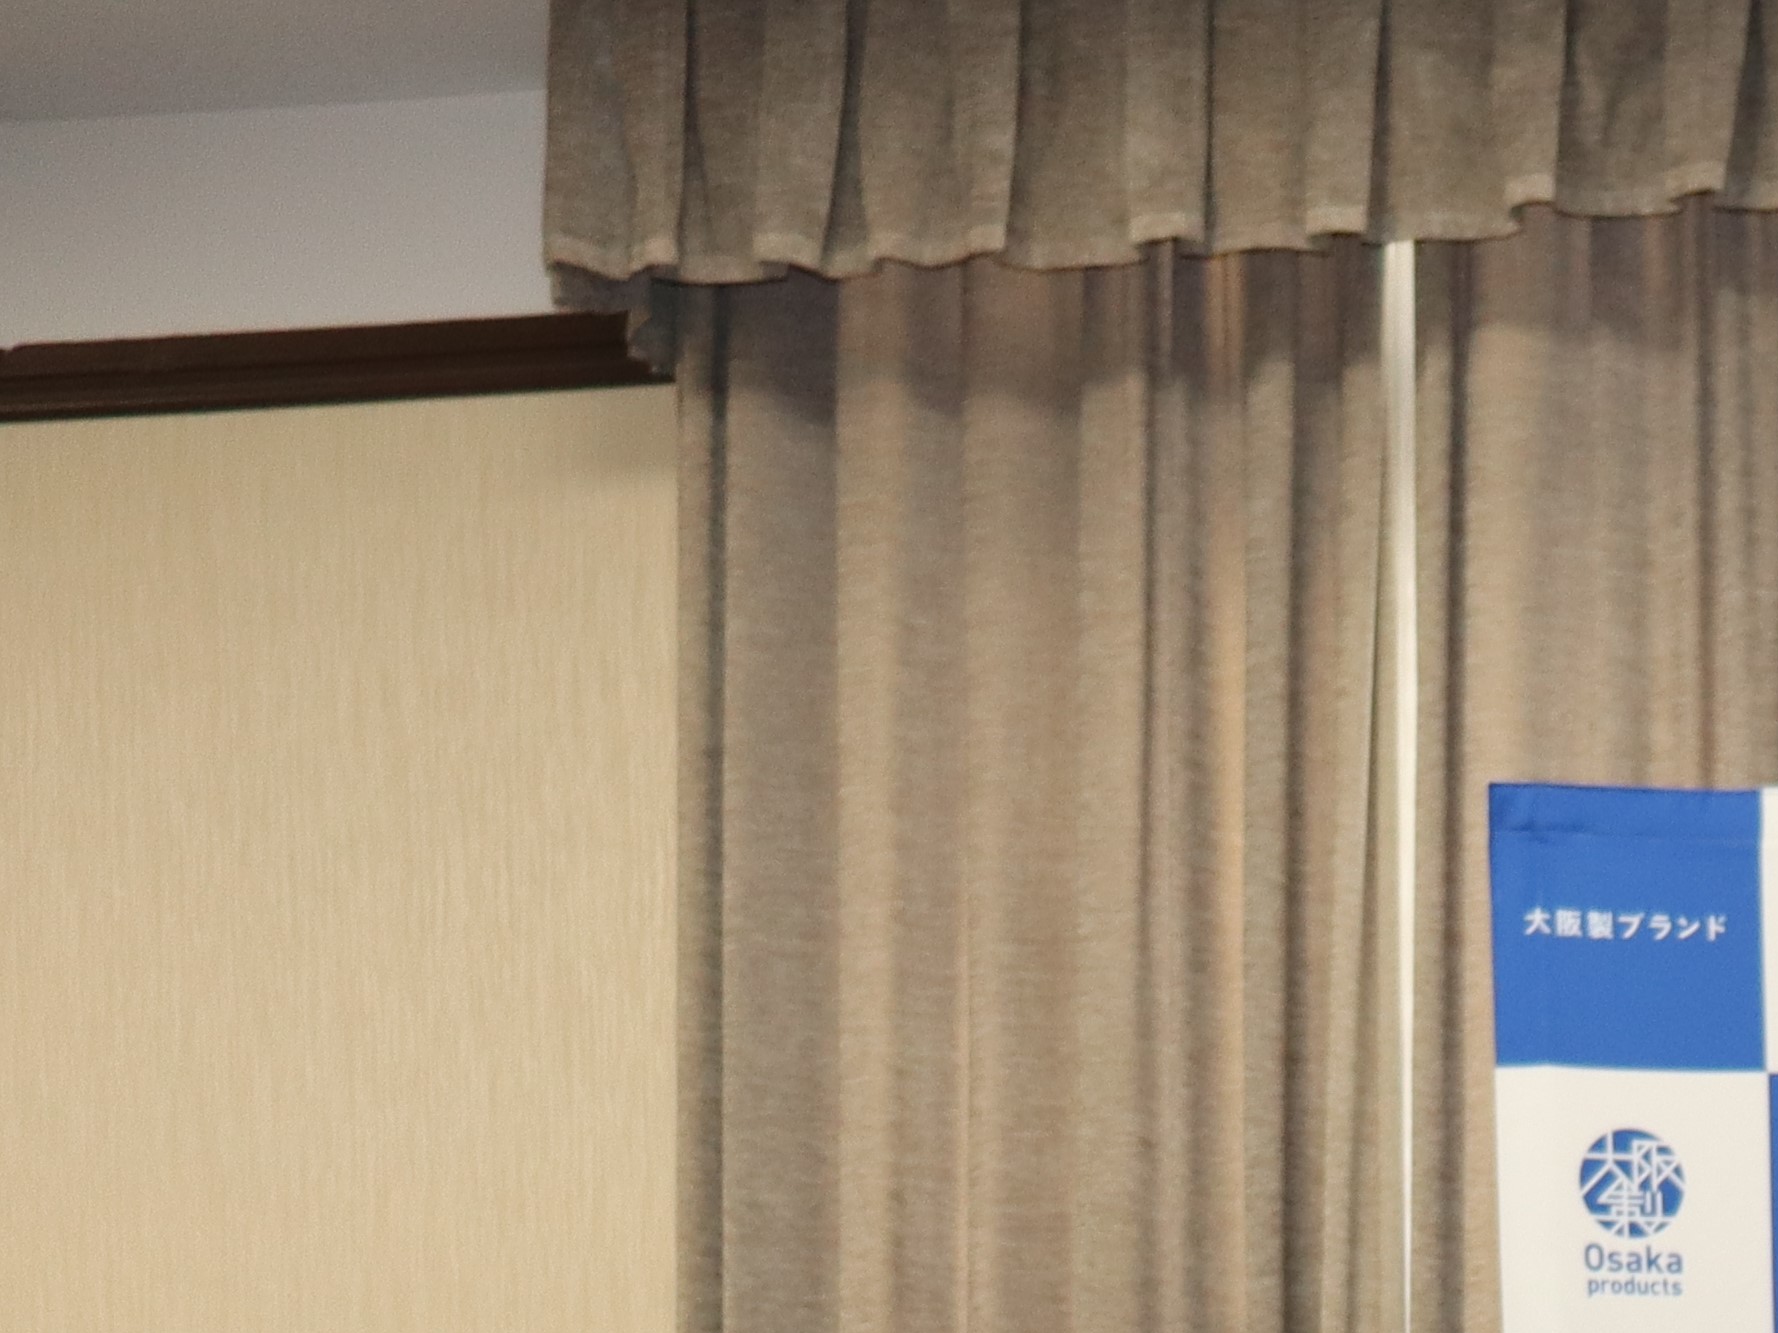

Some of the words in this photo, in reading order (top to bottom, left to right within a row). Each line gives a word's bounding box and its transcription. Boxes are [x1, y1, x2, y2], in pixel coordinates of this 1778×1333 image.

[1524, 907, 1726, 942] 大阪製ブランド
[1583, 1243, 1684, 1274] Osaka
[1587, 1277, 1683, 1297] products
